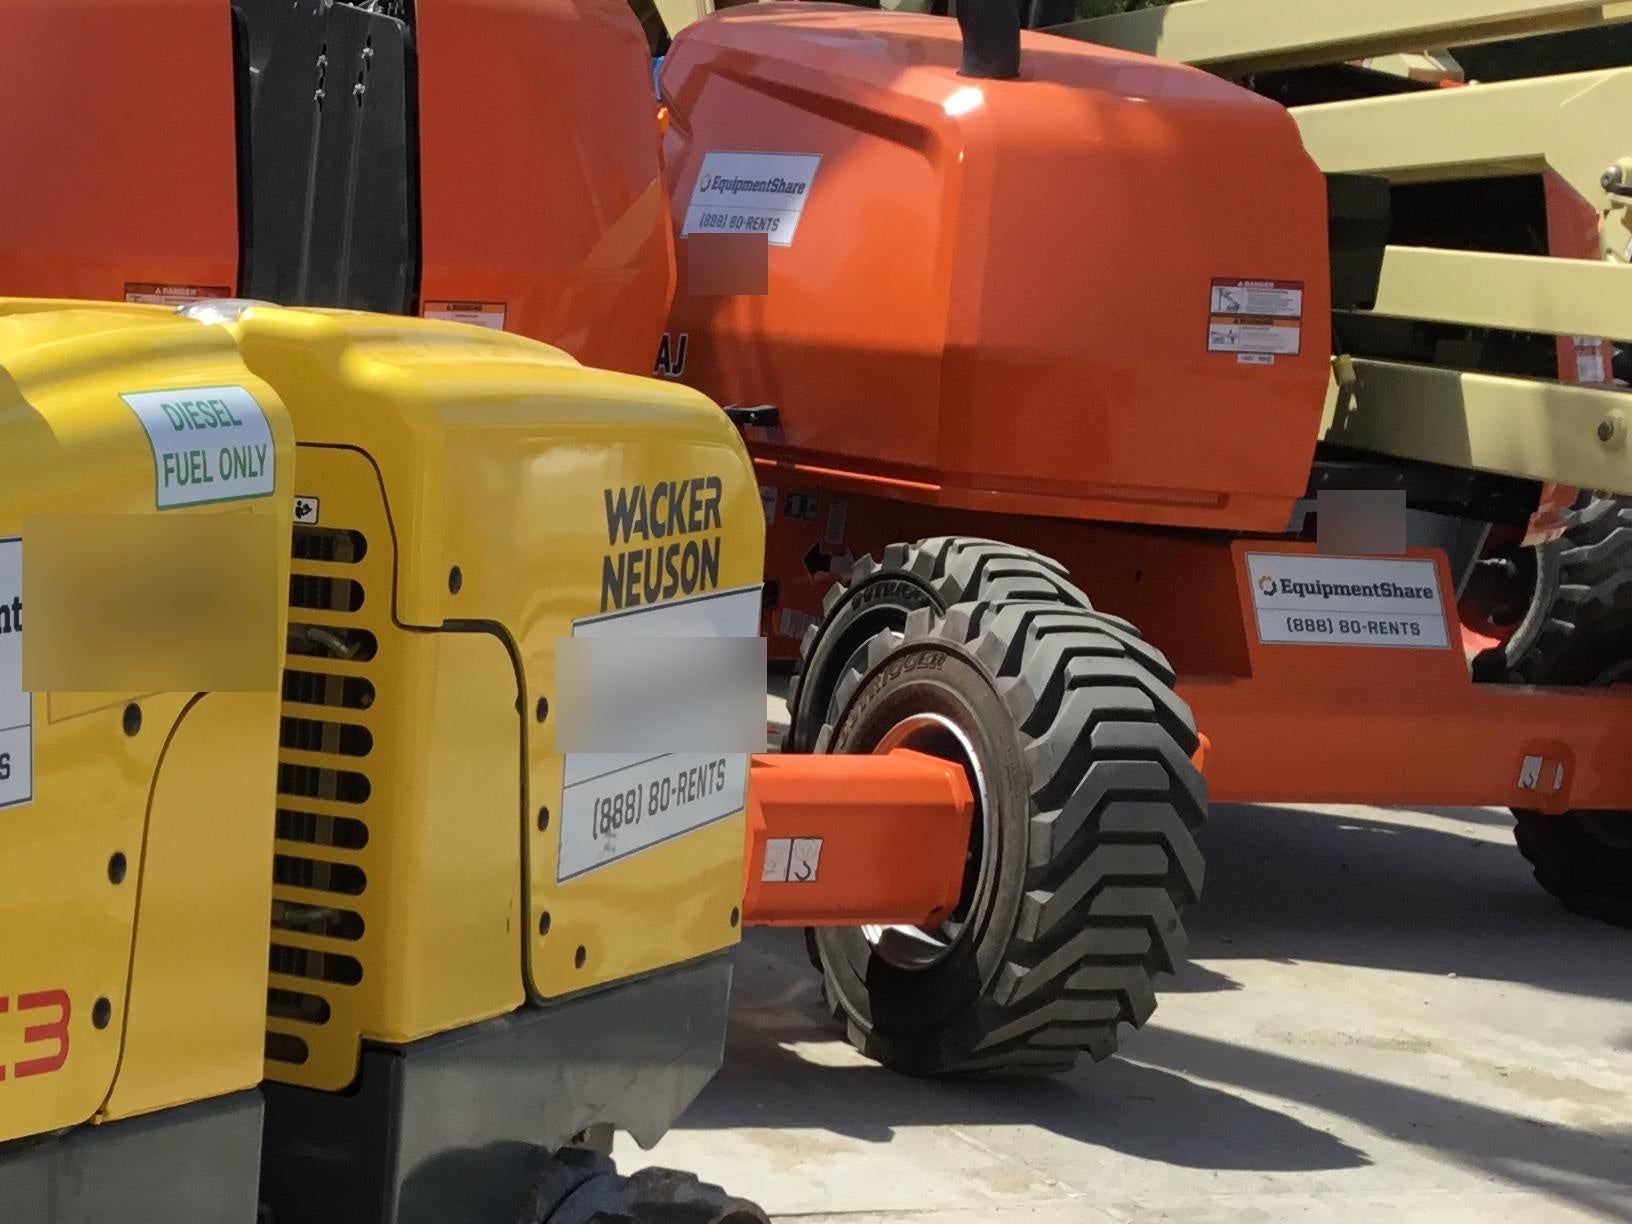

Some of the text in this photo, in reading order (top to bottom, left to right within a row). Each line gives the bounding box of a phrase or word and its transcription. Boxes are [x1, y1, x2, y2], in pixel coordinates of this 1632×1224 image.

[710, 175, 806, 195] EquipmentShare
[729, 215, 781, 232] 80-RENTS
[160, 399, 243, 432] DIESEL
[163, 443, 267, 488] FUEL ONLY
[603, 475, 723, 546] WACKER
[600, 536, 721, 613] NEUSON
[1279, 578, 1435, 600] EquipmentShare
[1286, 616, 1422, 637] (888) 80-RENTS
[592, 758, 727, 840] (888) 80-RENTS
